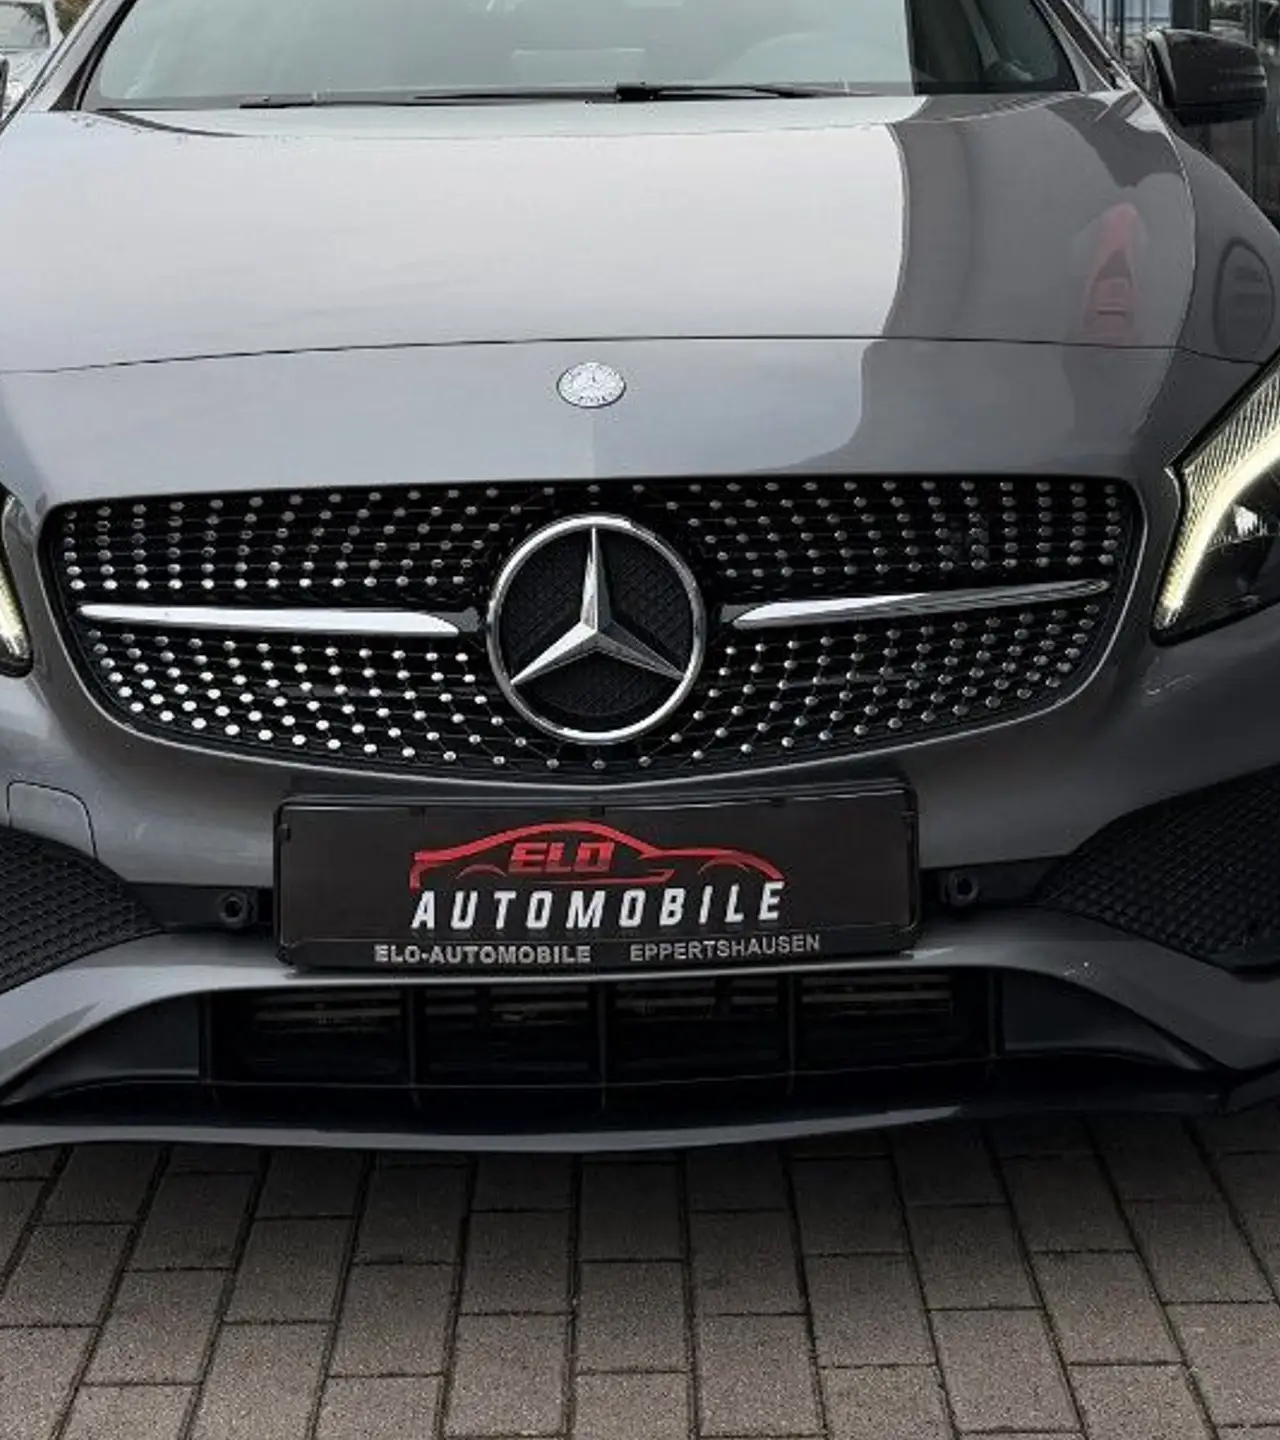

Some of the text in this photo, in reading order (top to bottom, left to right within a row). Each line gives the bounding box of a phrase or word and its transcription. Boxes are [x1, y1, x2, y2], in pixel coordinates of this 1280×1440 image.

[507, 841, 616, 874] ELO
[411, 880, 786, 931] AUTOMOBILE
[374, 933, 821, 965] ELO-AUTOMOBILE EPPERTSHAUSEN
